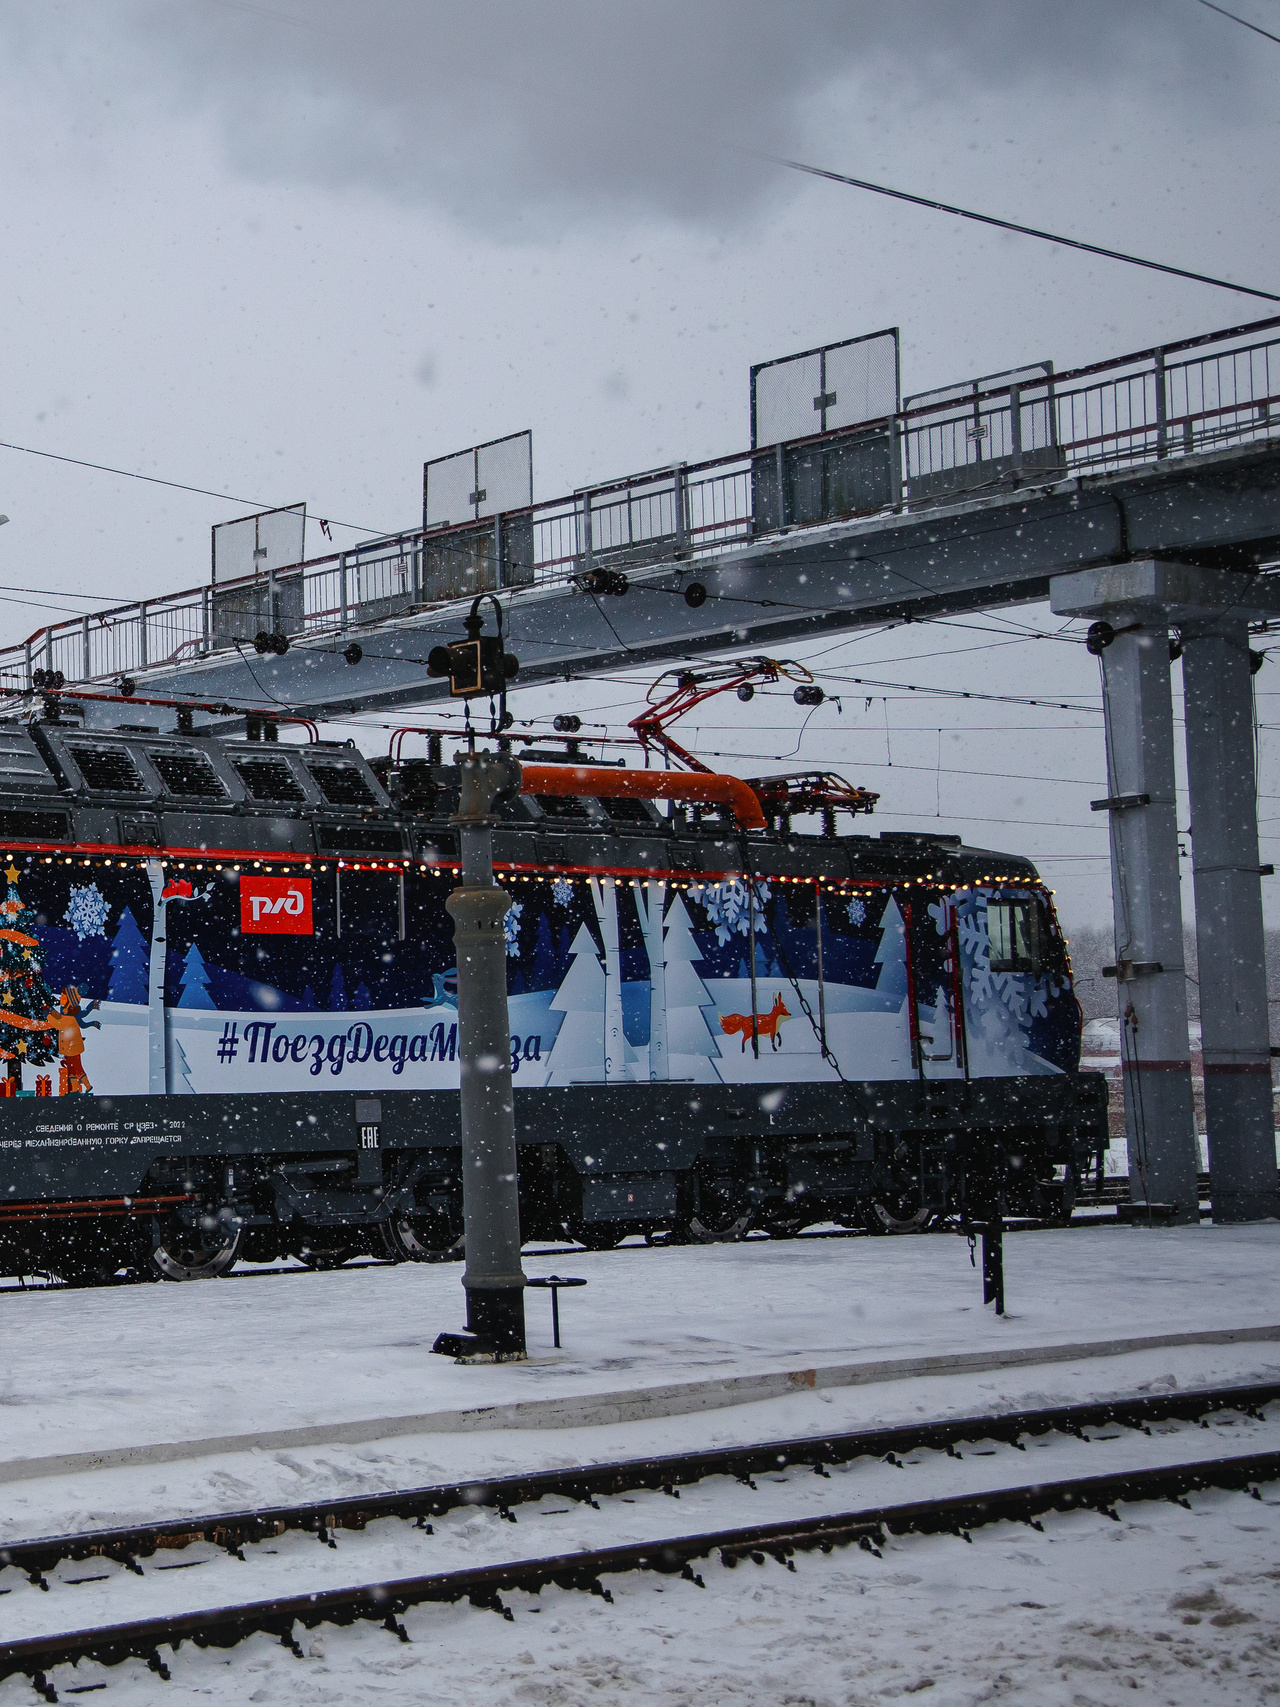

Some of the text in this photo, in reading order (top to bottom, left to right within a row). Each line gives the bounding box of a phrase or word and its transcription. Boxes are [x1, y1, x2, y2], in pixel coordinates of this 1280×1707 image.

[217, 1021, 542, 1076] #ПоездДедаМза
[35, 1124, 73, 1133] СВЕДЕНИЯ
[76, 1124, 83, 1132] О
[86, 1122, 119, 1131] РЕМОНТЕ
[106, 1136, 129, 1145] ГОРКУ
[132, 1134, 182, 1144] ЗАПРЕЩАЕТСЯ
